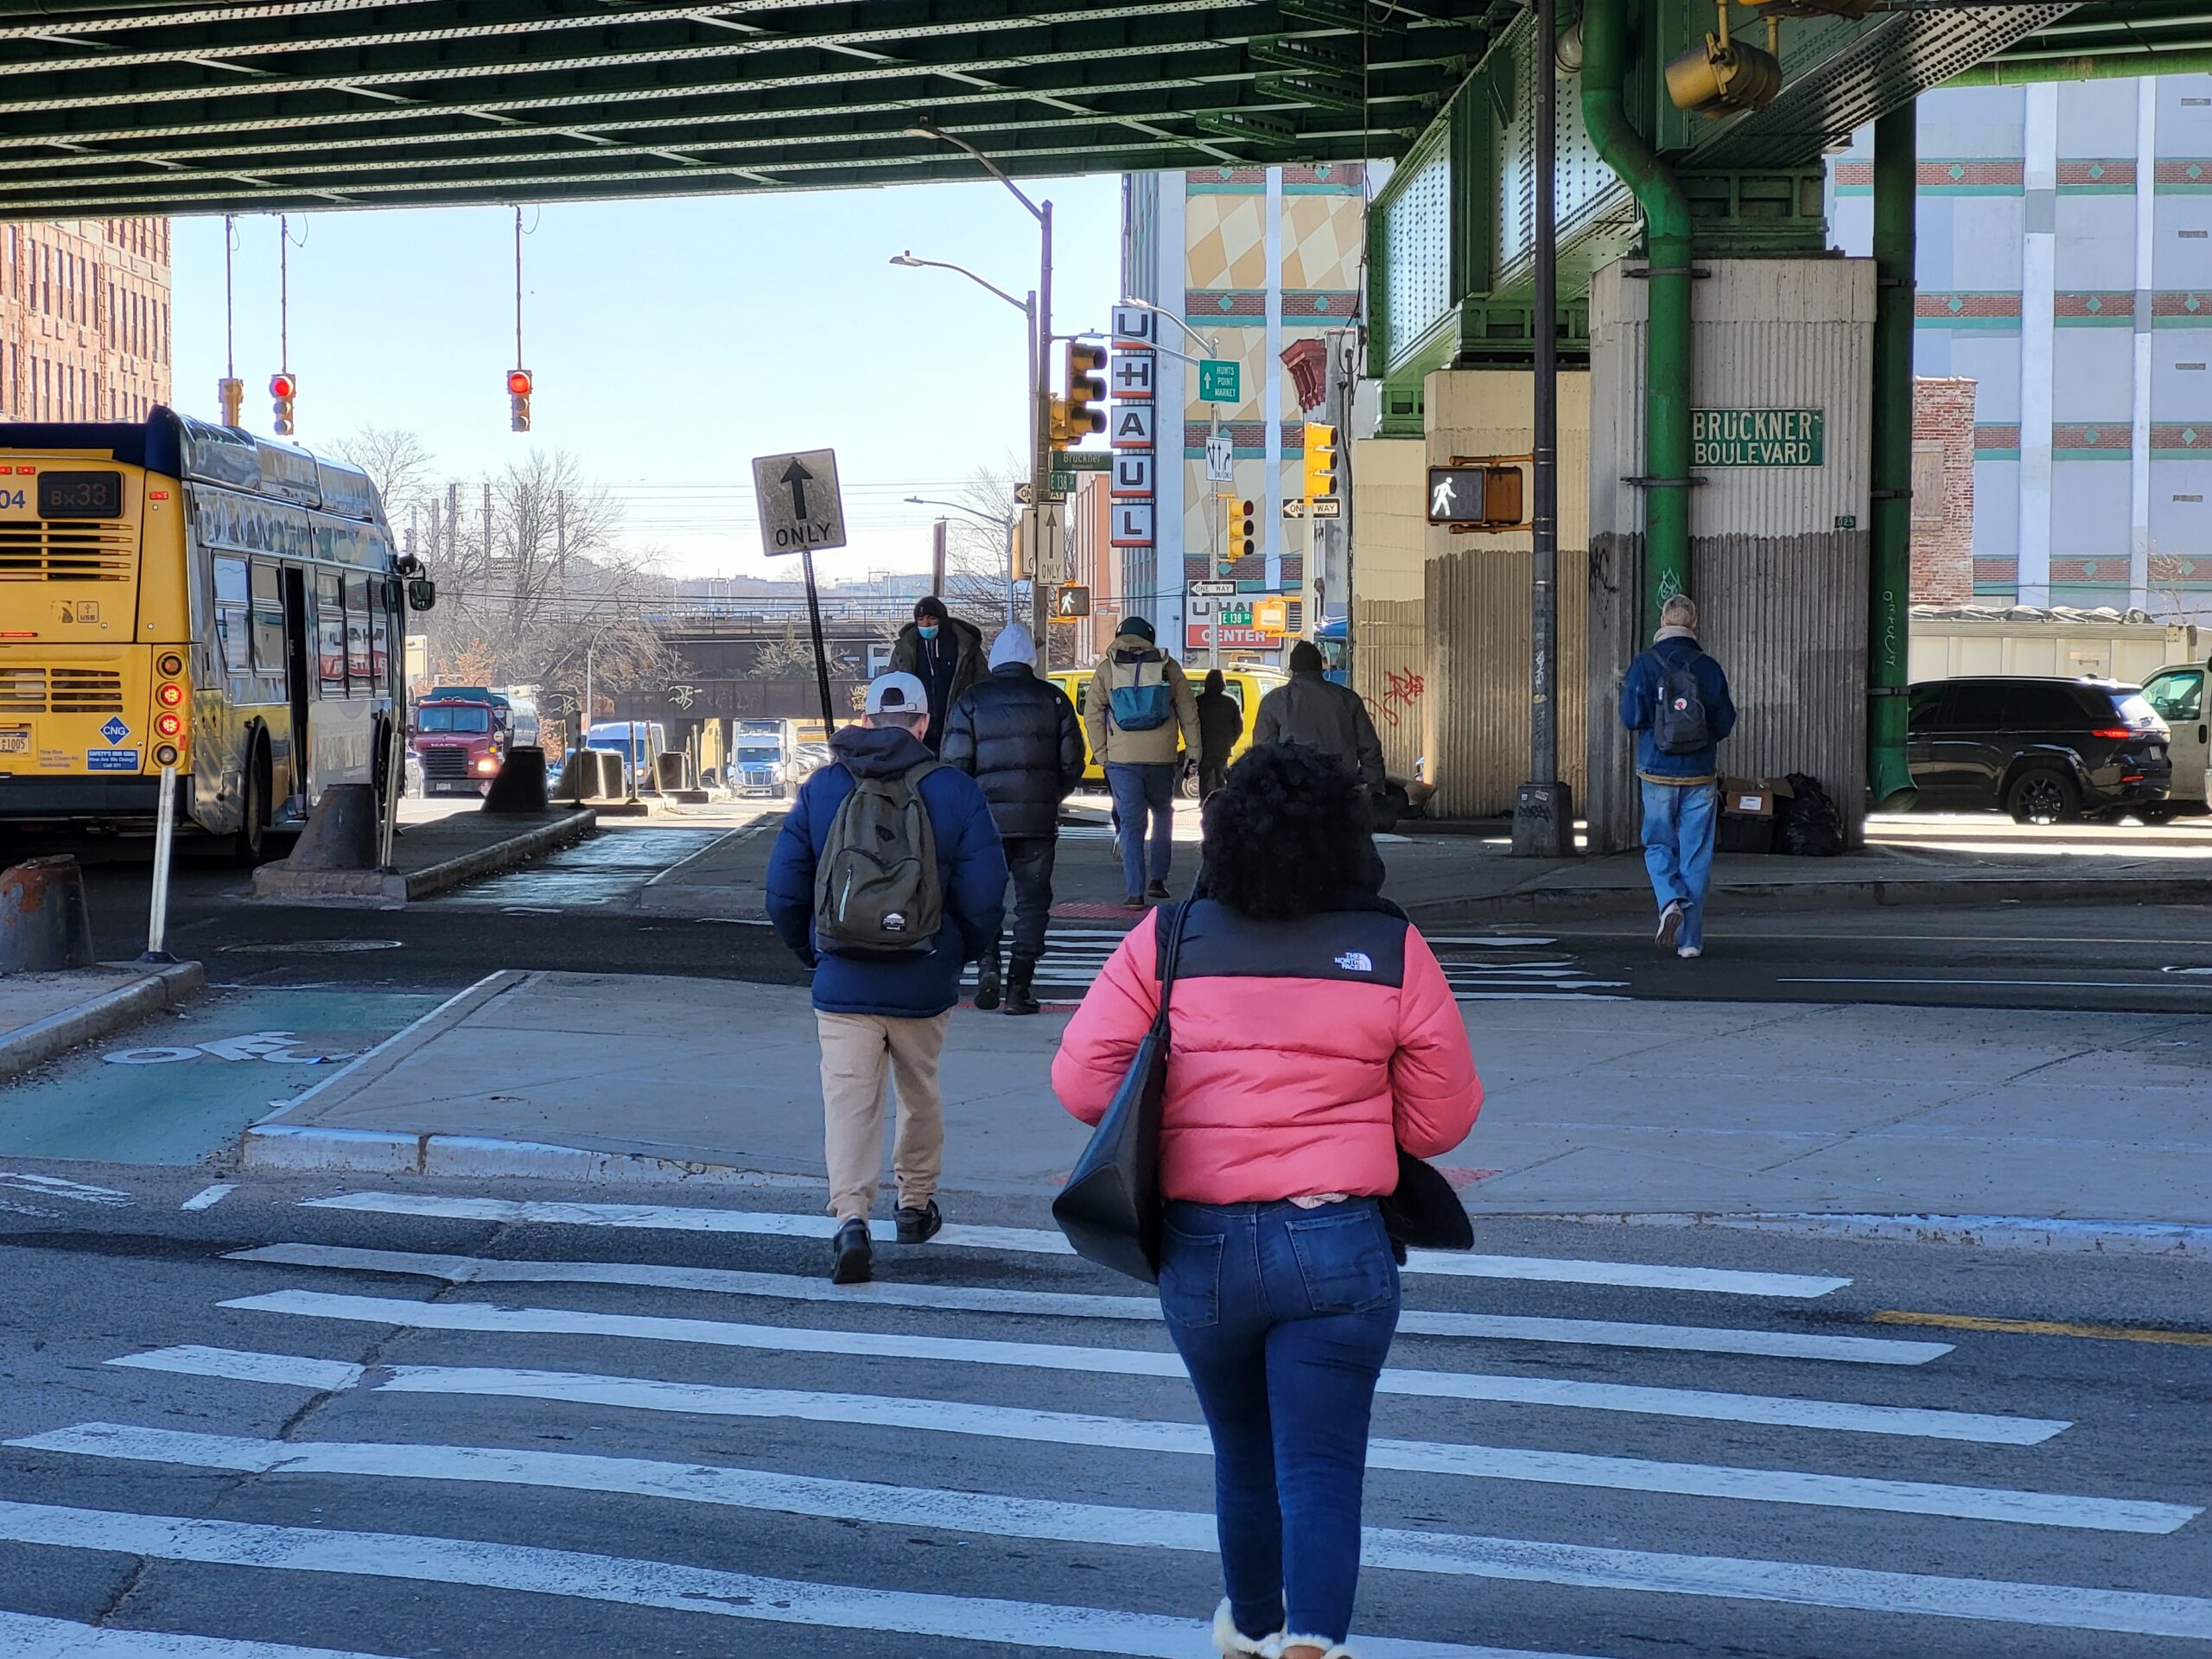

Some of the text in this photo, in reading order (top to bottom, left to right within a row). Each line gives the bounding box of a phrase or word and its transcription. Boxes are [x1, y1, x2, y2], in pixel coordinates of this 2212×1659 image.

[1217, 366, 1234, 375] HUNTS
[1217, 377, 1234, 386] POINT
[1215, 388, 1236, 397] MARKET
[1693, 412, 1812, 441] BRUCKNER
[1064, 453, 1100, 463] Bruckner
[1694, 442, 1811, 464] BOULEVARD
[1051, 474, 1055, 489] E
[1057, 474, 1068, 490] 138
[51, 483, 106, 505] Bx33
[1021, 489, 1032, 498] ON
[776, 523, 830, 546] ONLY
[1041, 564, 1061, 579] ONLY
[1223, 613, 1227, 623] E
[1230, 613, 1242, 623] 138
[103, 726, 126, 735] CNG
[7, 738, 25, 749] 1005
